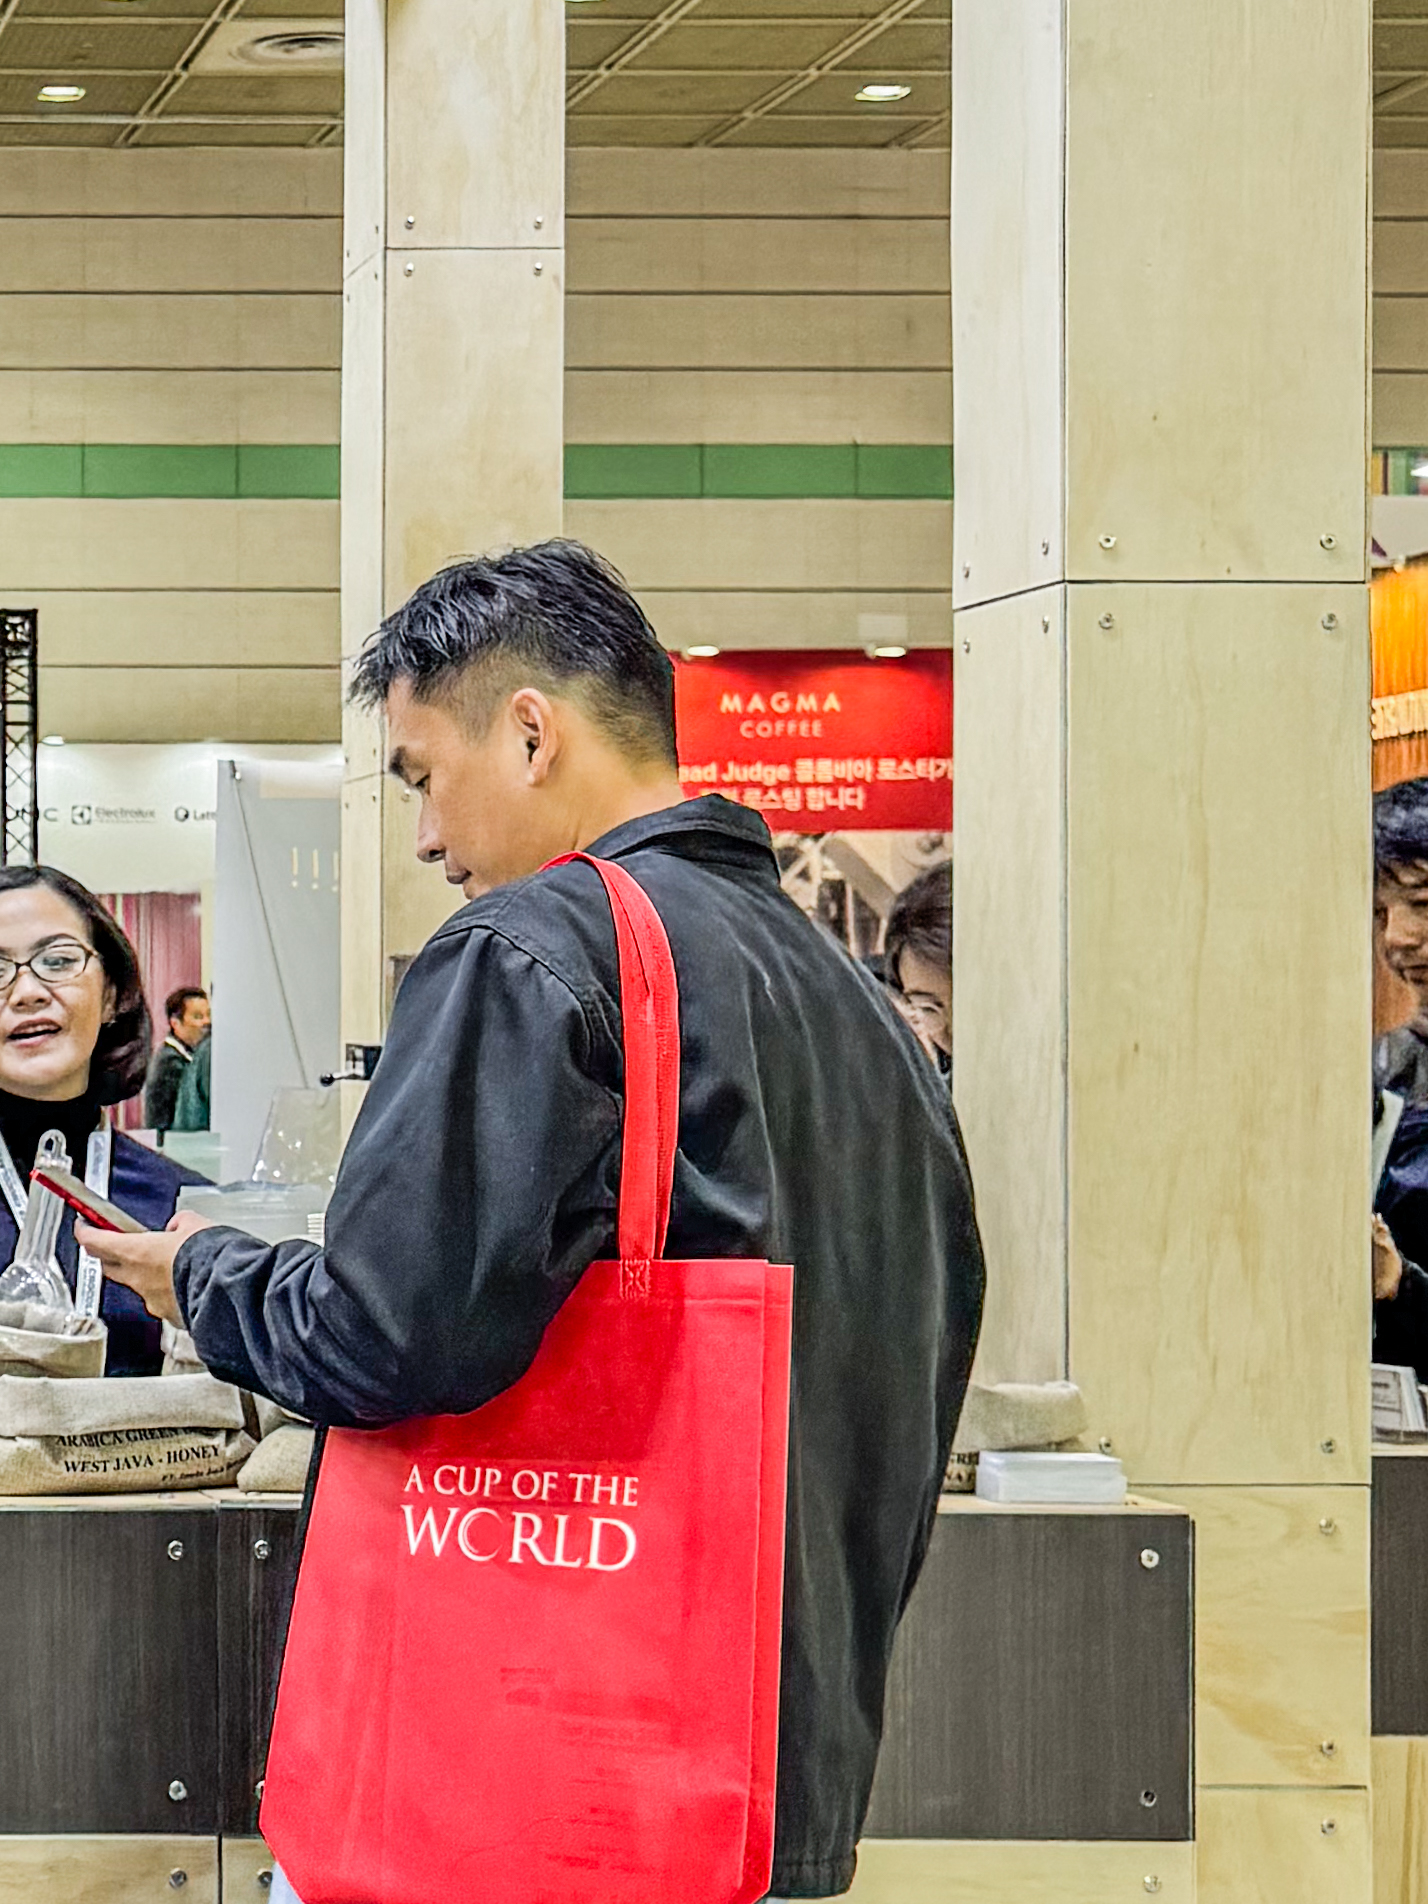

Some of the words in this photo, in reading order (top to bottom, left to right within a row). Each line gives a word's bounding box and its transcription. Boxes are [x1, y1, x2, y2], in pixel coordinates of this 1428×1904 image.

[720, 691, 841, 714] MAGMA
[739, 719, 824, 739] COFFEE
[721, 760, 791, 786] Judge
[805, 786, 865, 812] 합니다
[55, 1432, 123, 1447] ARABICA
[64, 1459, 111, 1474] WEST
[112, 1454, 154, 1472] JAVA
[167, 1444, 221, 1465] HONEY
[403, 1464, 426, 1494] A
[433, 1465, 502, 1497] CUP
[511, 1469, 559, 1500] OF
[569, 1473, 640, 1508] THE
[400, 1504, 638, 1572] WORLD
